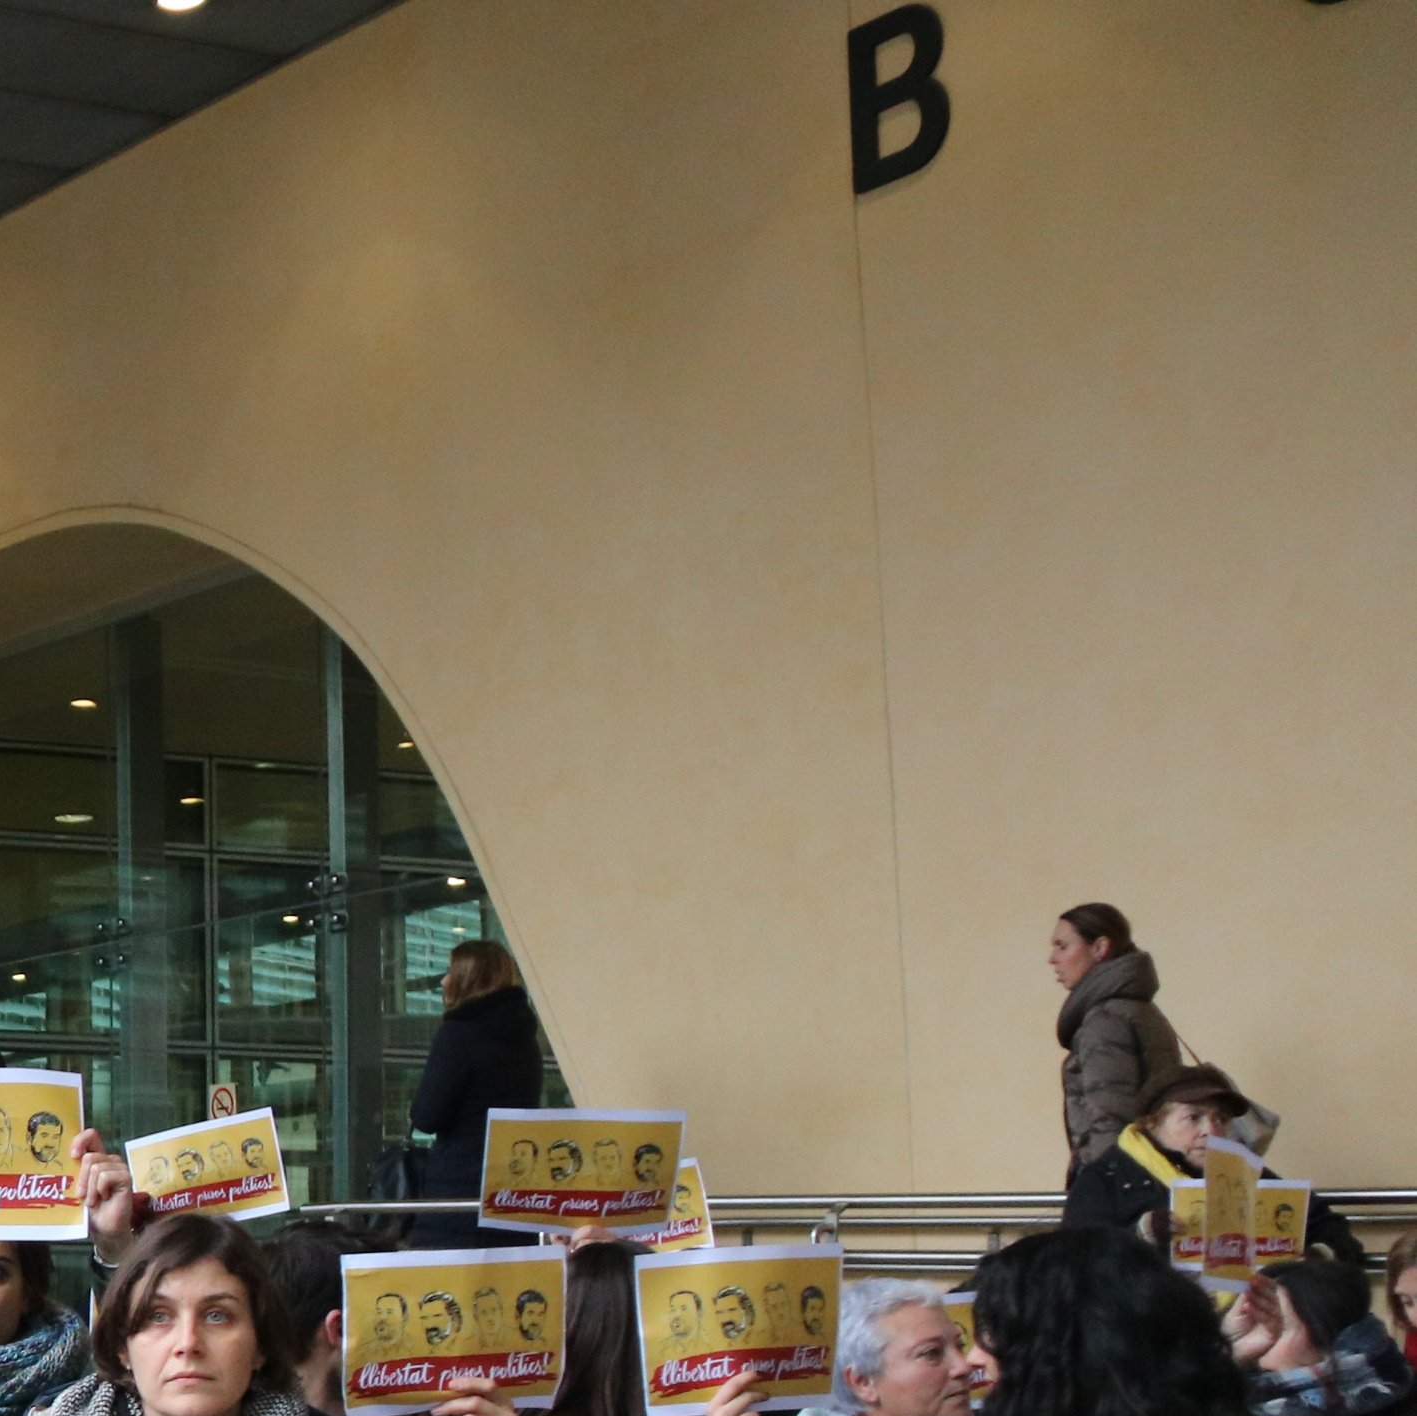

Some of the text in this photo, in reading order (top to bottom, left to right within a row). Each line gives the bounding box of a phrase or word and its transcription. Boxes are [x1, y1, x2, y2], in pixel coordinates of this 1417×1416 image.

[847, 3, 951, 196] B
[358, 1362, 435, 1390] llibertat
[659, 1356, 736, 1387] llibertat
